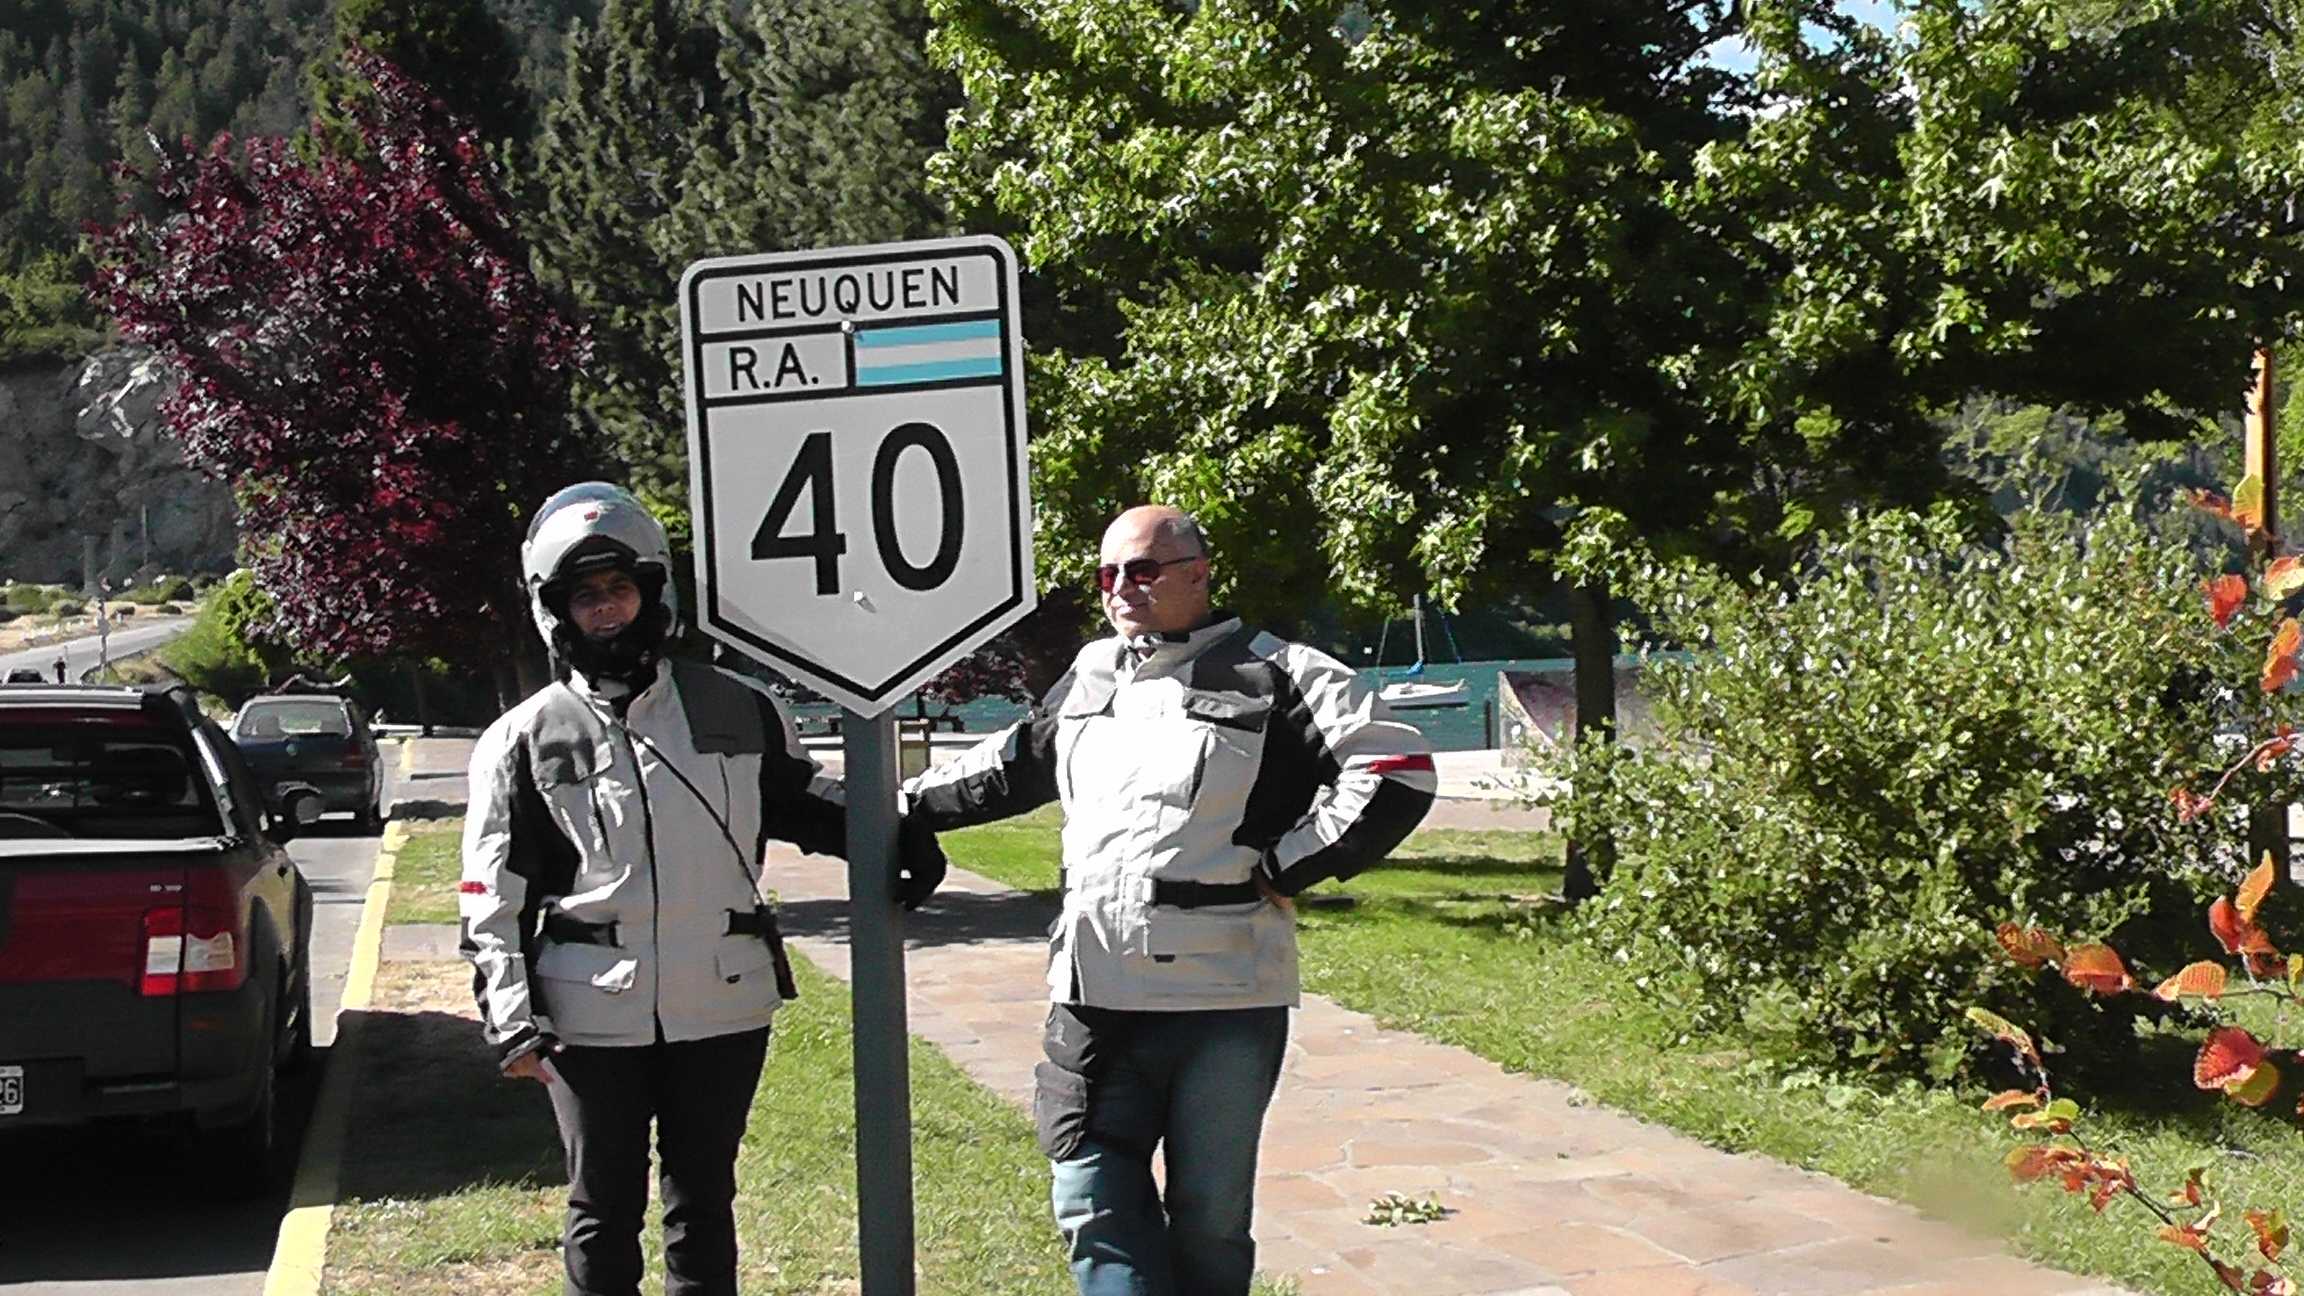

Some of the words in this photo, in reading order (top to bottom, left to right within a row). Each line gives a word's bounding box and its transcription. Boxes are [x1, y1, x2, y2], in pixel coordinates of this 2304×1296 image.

[737, 265, 959, 322] NEUQUEN
[728, 342, 820, 391] R.A.
[750, 421, 964, 596] 40
